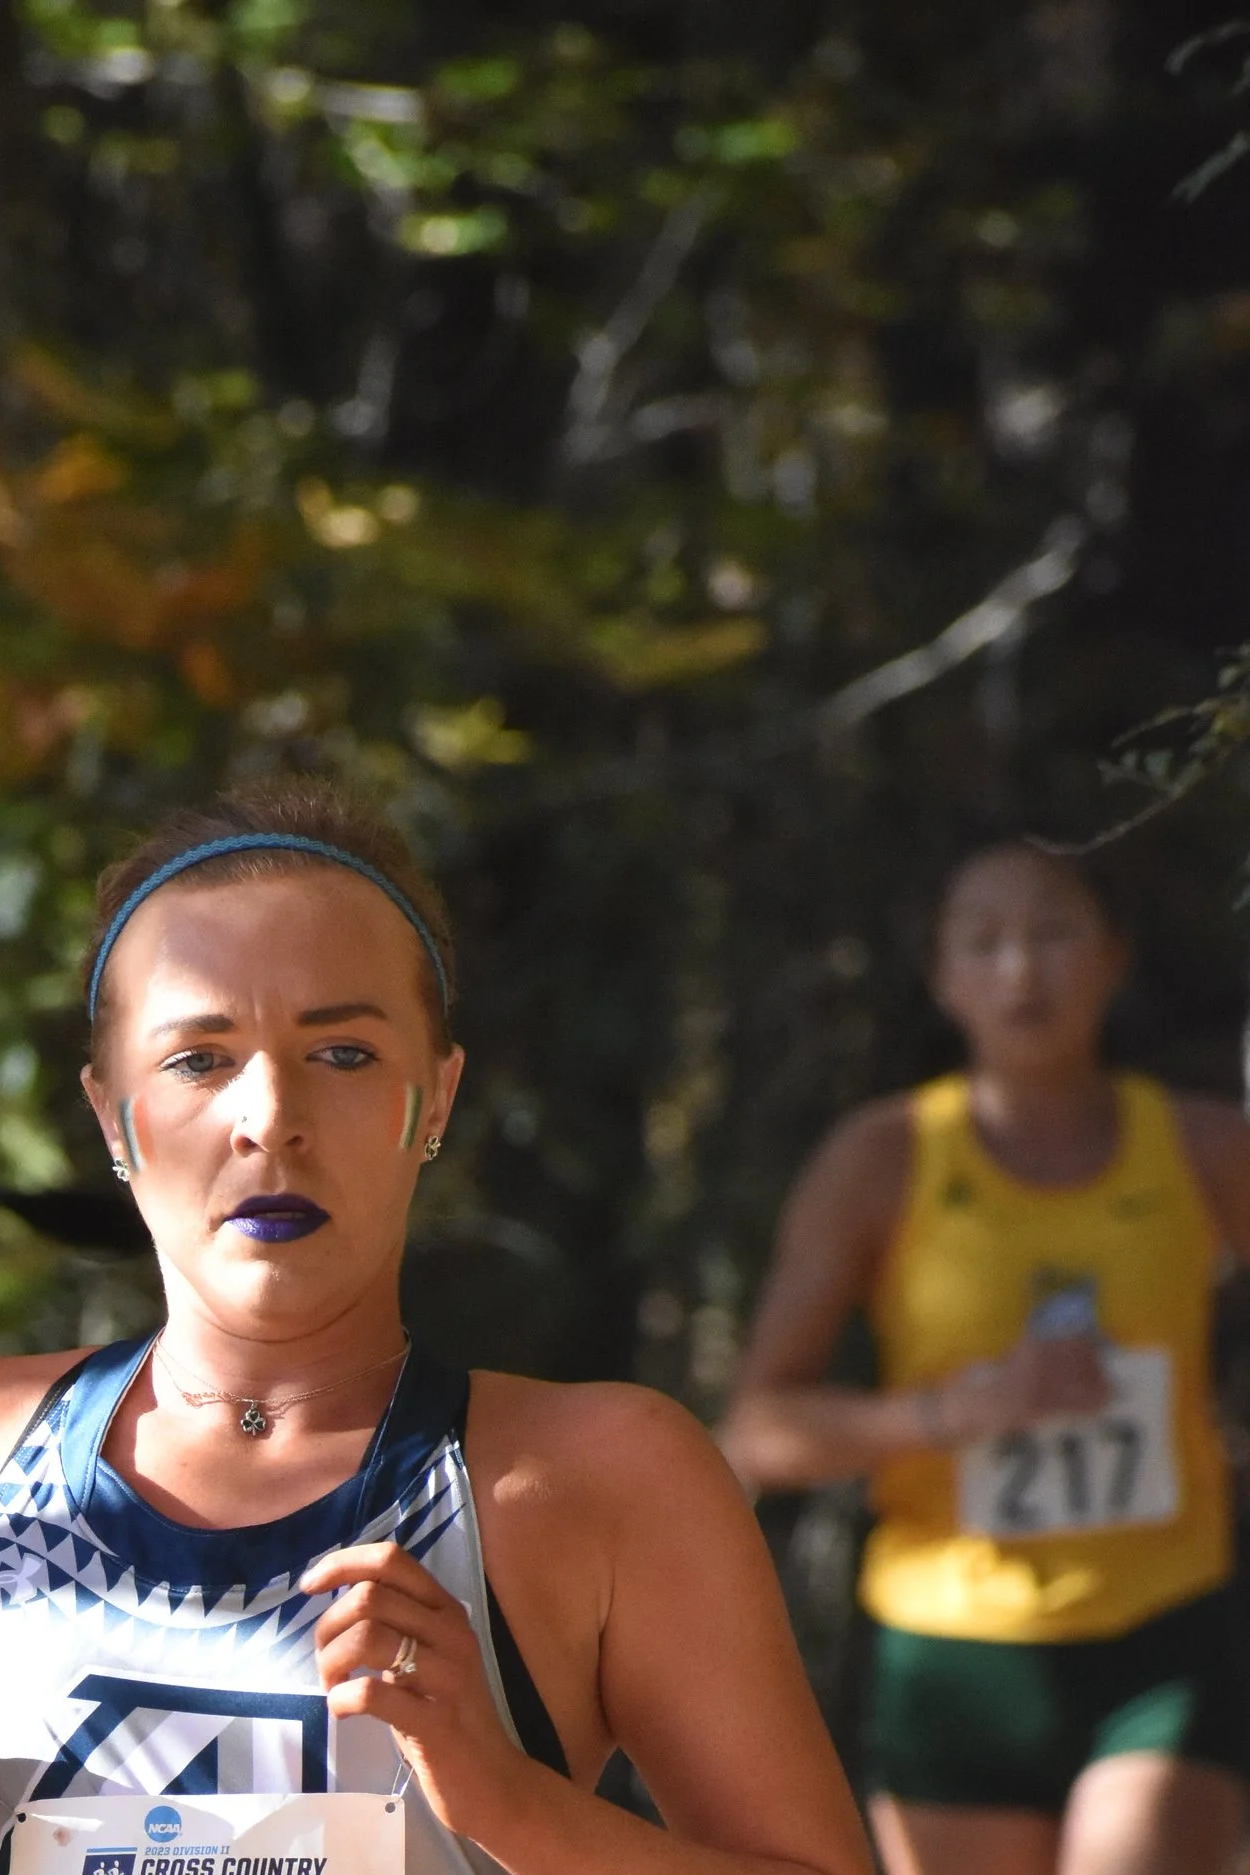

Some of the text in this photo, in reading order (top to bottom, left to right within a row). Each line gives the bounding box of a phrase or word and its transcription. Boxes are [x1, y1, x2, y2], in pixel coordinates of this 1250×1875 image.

[995, 1419, 1141, 1525] 217
[148, 1823, 181, 1834] NCAA
[144, 1845, 230, 1856] 2023 DIVISION II
